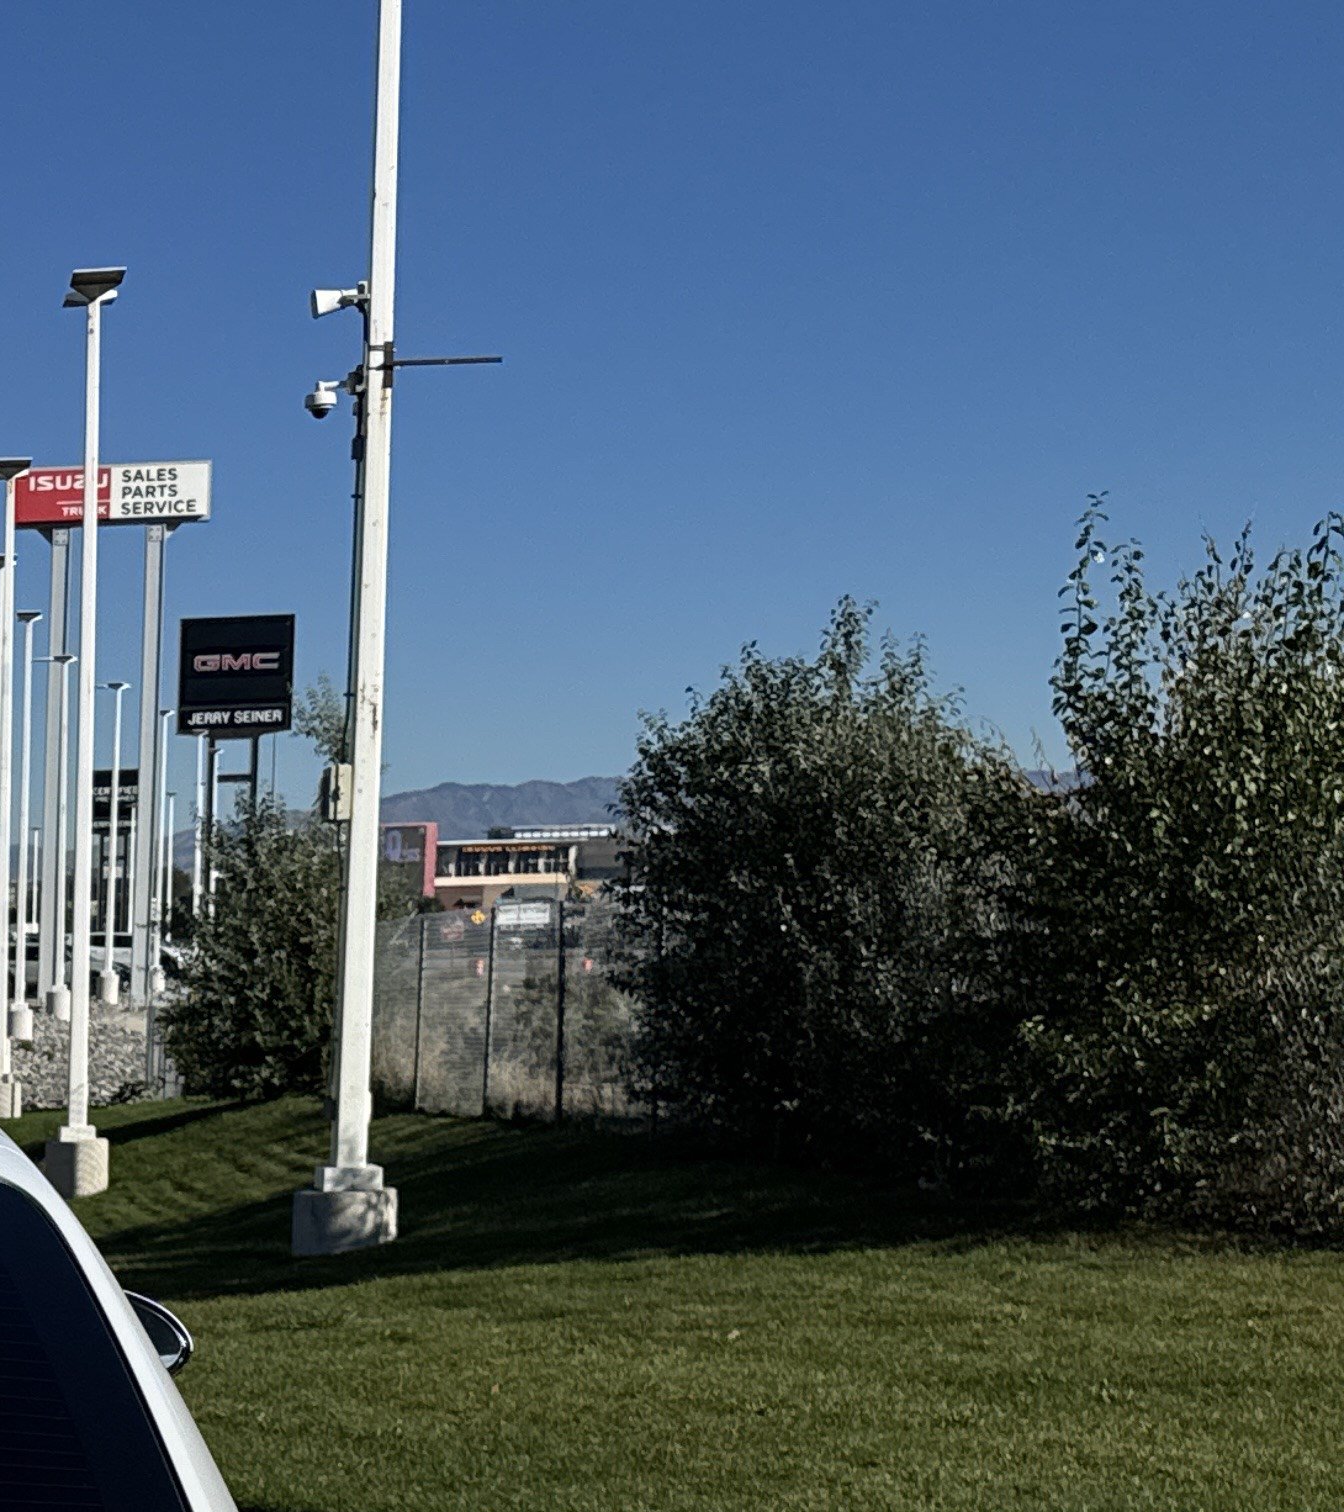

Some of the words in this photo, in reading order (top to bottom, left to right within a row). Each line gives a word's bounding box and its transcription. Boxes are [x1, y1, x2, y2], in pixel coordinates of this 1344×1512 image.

[29, 473, 108, 492] ISUZU
[121, 468, 178, 483] SALES
[121, 484, 178, 499] PARTS
[61, 505, 107, 517] TRK
[121, 499, 197, 515] SERVICE
[193, 652, 280, 672] GMC
[187, 710, 230, 726] JERRY
[234, 708, 282, 724] SEINER
